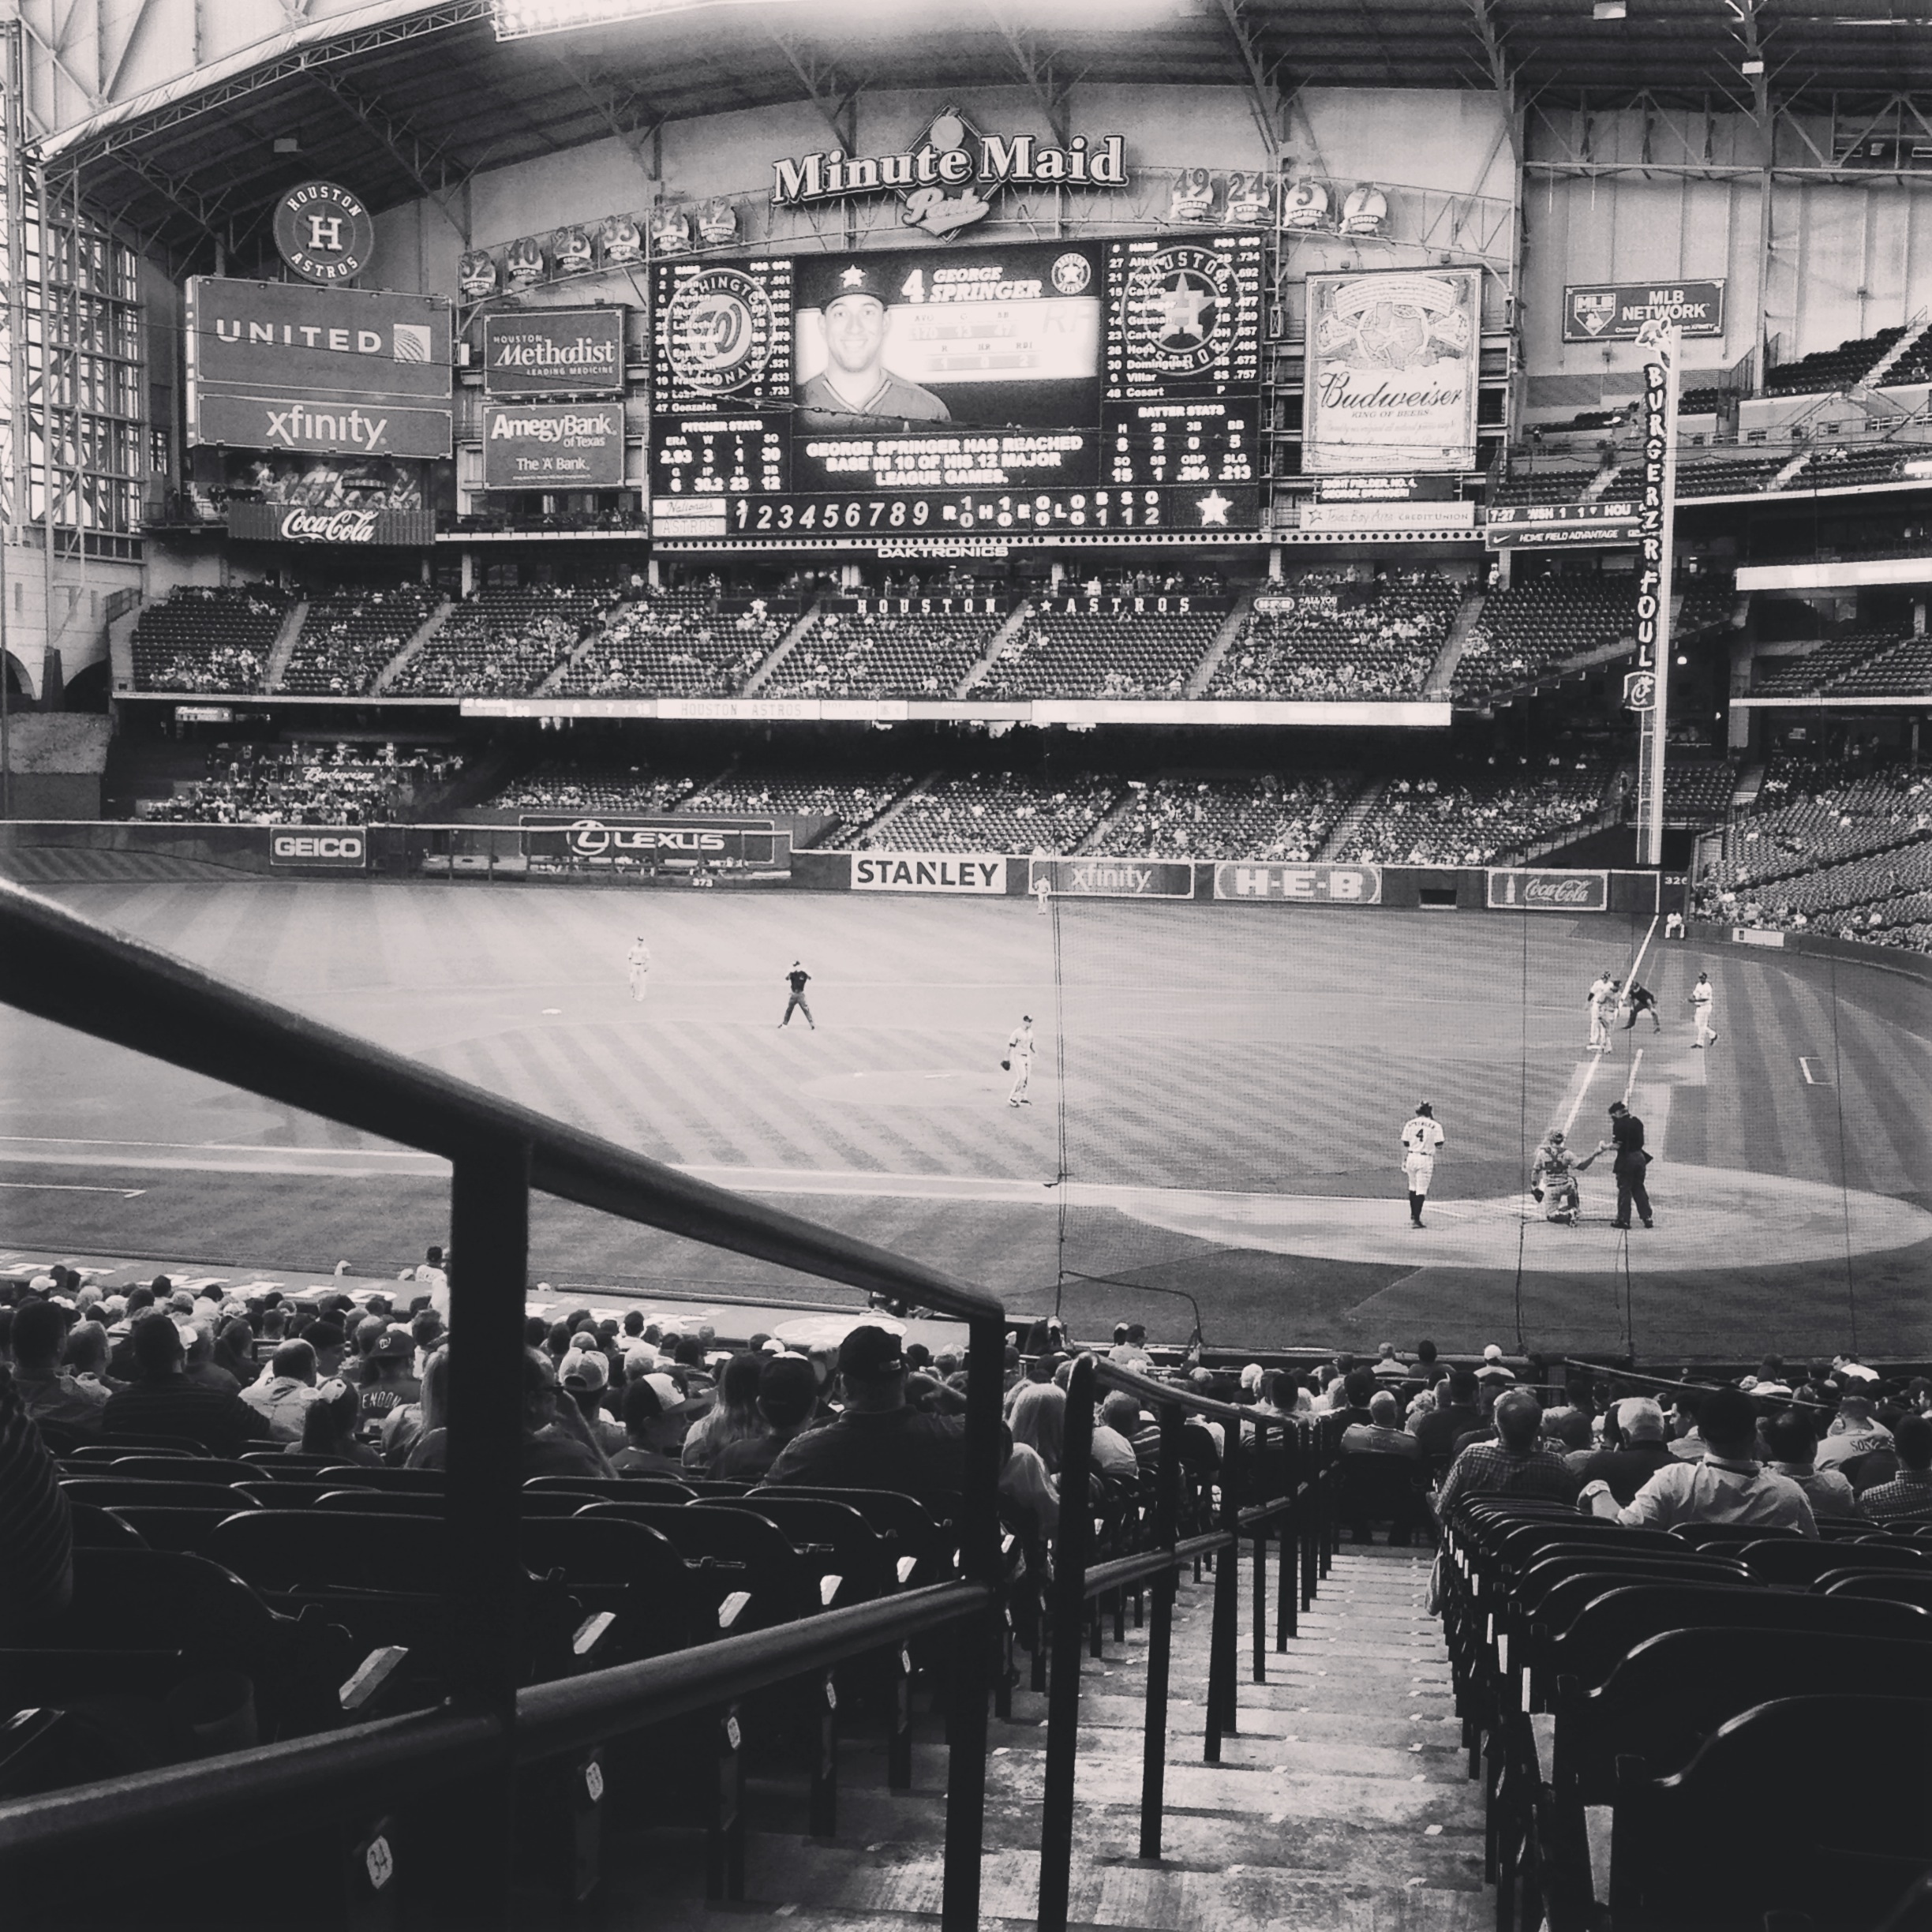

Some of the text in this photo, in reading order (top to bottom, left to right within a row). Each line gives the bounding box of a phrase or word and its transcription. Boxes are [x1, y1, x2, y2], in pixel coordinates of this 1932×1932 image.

[773, 136, 1125, 203] Minute Maid
[1229, 172, 1267, 200] 24
[1297, 177, 1313, 205] 5
[286, 186, 362, 216] HOUSTON
[1356, 182, 1374, 212] 7
[308, 214, 343, 250] H
[508, 238, 537, 265] 40
[291, 253, 358, 278] ASTROS
[1109, 259, 1124, 268] 27
[933, 267, 1003, 283] GEORGE
[1109, 273, 1121, 282] 21
[901, 269, 925, 303] 4
[930, 280, 1042, 302] SPRINGER
[1578, 297, 1613, 309] MLB
[1649, 290, 1684, 305] MLB
[1623, 304, 1706, 320] NETWORK
[215, 319, 382, 354] UNITED
[493, 335, 542, 343] HOUSTON
[1108, 331, 1121, 340] 23
[1214, 328, 1230, 337] DH
[494, 337, 615, 366] Methodist
[1108, 361, 1121, 369] 30
[1126, 373, 1157, 382] Villar
[1214, 371, 1229, 380] SS
[1126, 387, 1164, 397] Cosart
[1319, 371, 1462, 409] Budweiser
[1186, 405, 1225, 416] STATS
[266, 405, 388, 451] xfinity
[491, 413, 612, 442] AmegyBank
[728, 420, 762, 430] STATS
[564, 436, 605, 447] of Texas
[666, 433, 779, 446] ERA SO
[806, 436, 1083, 457] GEORGE SPRINGER HAS REACHED
[1642, 366, 1664, 530] BURGERZ
[762, 447, 781, 461] 30
[826, 452, 1062, 471] BASE IN 10 OF HIS 12 MAJOR
[1114, 454, 1247, 466] SO OBP SLG
[516, 458, 539, 470] The
[556, 457, 586, 470] Bank
[761, 476, 781, 490] 12
[875, 471, 942, 485] LEAGUE
[1112, 468, 1133, 481] 15
[1322, 479, 1350, 489] RIGHT
[1121, 491, 1133, 505] S
[757, 501, 1031, 529] 2 3 4 5 6 7 8 9 R H E
[1145, 507, 1159, 525] 2
[1490, 509, 1515, 522] 7:27
[1604, 504, 1631, 516] HOU
[281, 507, 379, 542] Coca-Cola
[1545, 532, 1567, 541] FIELD
[1568, 530, 1619, 540] ADVANTAGE
[878, 546, 1009, 559] DAKTRONICS
[857, 597, 1190, 614] HOUSTON ASTROS
[1638, 573, 1657, 667] FOUL
[680, 702, 803, 717] HOUSTON ASTROS
[301, 766, 375, 782] Budweiser
[274, 837, 362, 859] GEICO
[614, 832, 725, 850] LEXUS
[856, 859, 999, 887] STANLEY
[1071, 862, 1152, 893] xfinity
[692, 878, 713, 887] 373
[1236, 868, 1364, 898] H-E-B
[1525, 878, 1593, 902] Coca-Cola
[1415, 1129, 1424, 1142] 4
[361, 1391, 402, 1410] ENDON
